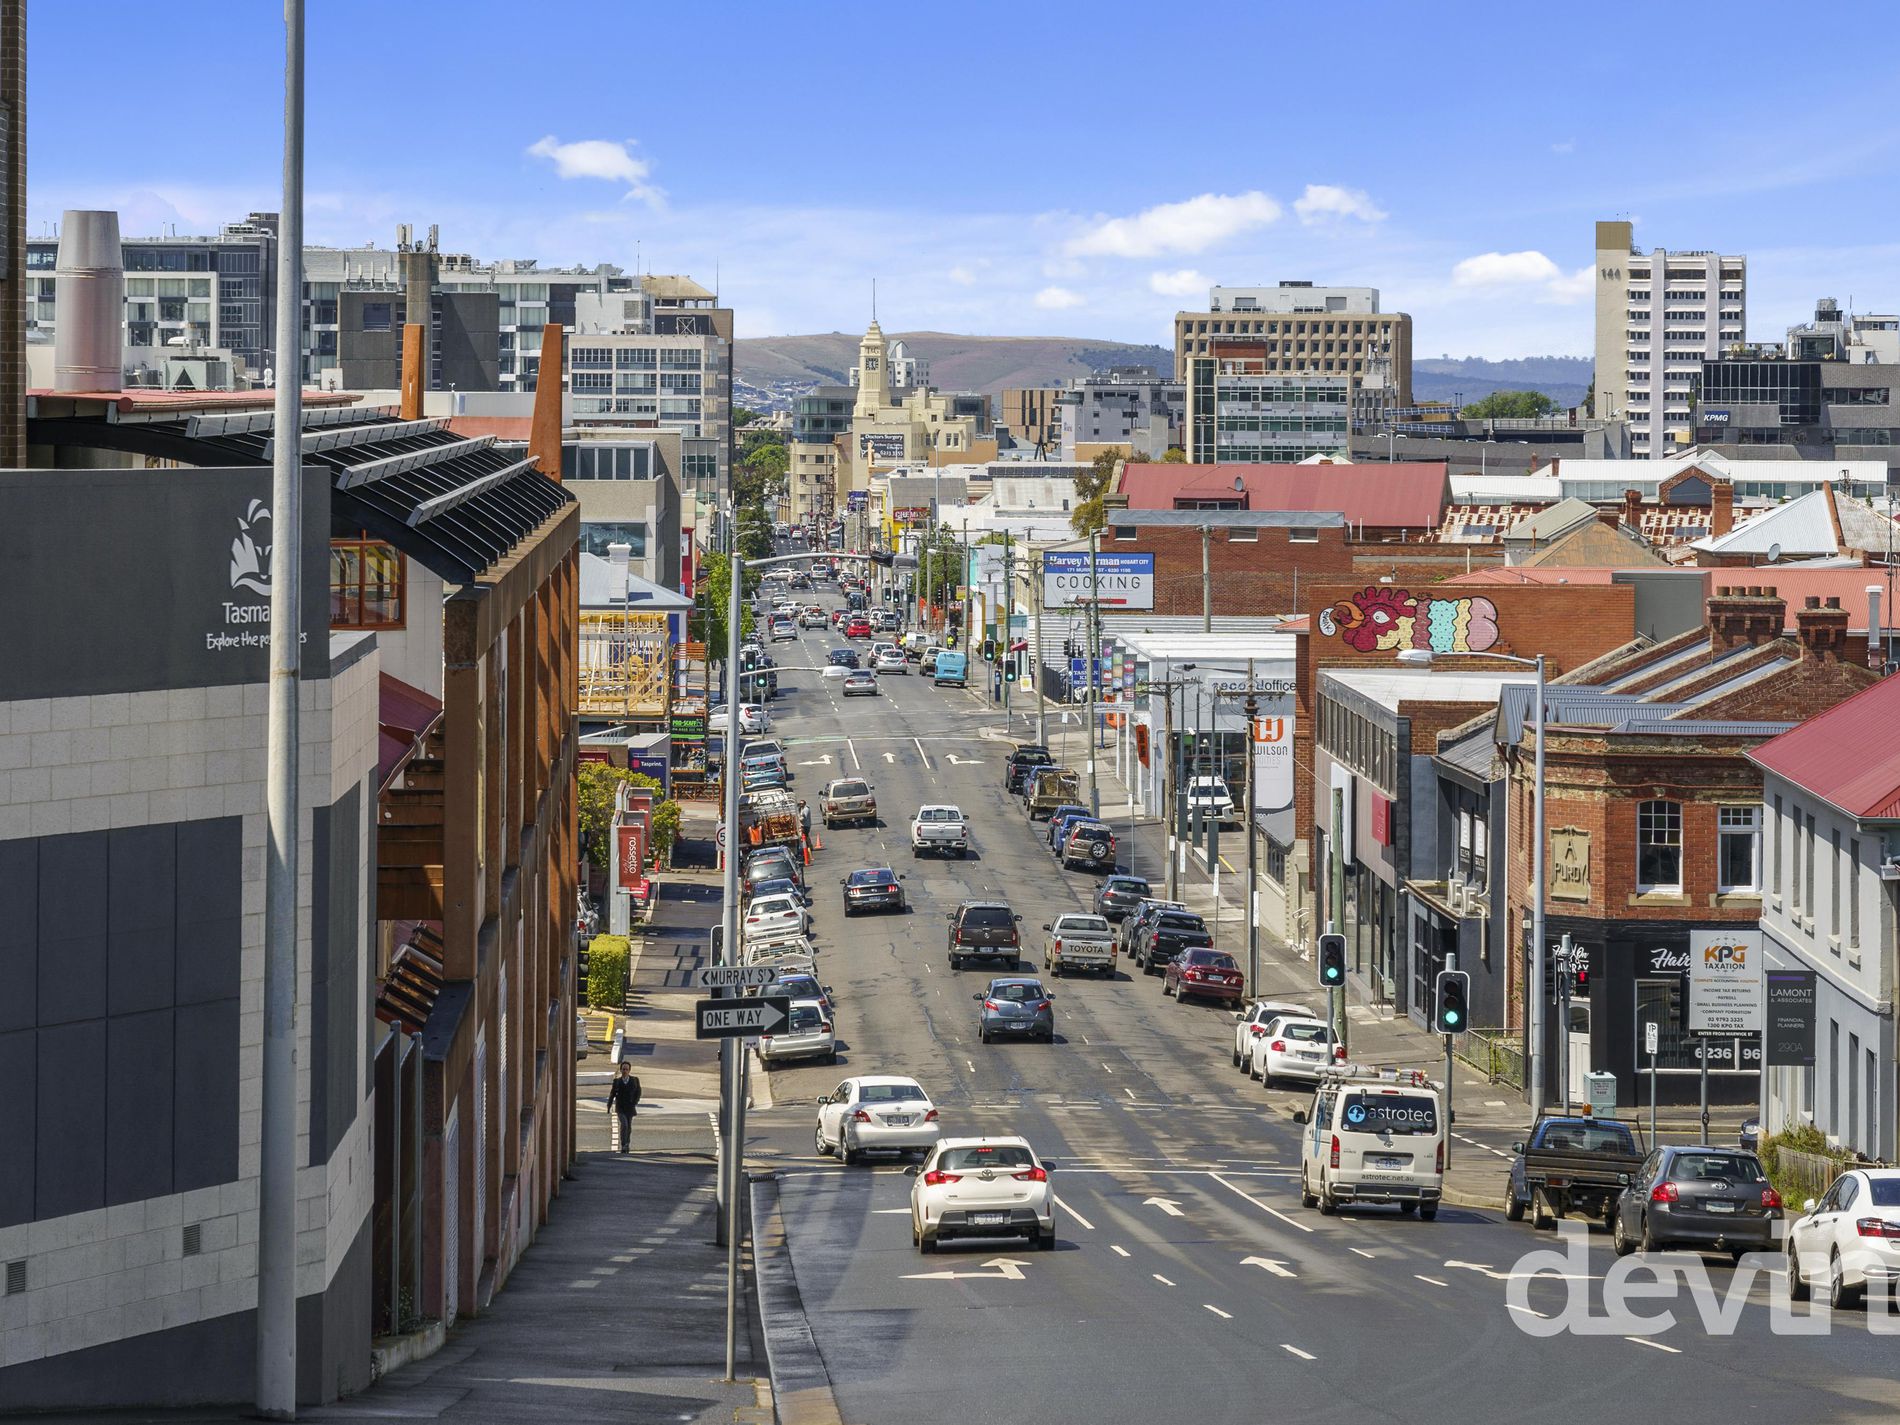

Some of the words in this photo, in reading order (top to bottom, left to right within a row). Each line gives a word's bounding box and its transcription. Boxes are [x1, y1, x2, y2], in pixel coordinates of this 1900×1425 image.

[1703, 414, 1728, 422] KPMG
[1049, 556, 1082, 567] Harvey
[1083, 556, 1120, 566] Nrman
[1056, 576, 1140, 589] COOKING
[222, 602, 271, 624] Tasma
[206, 632, 240, 651] Explore
[241, 631, 259, 647] the
[1254, 745, 1288, 756] WILSON
[628, 836, 637, 874] rossetto
[1565, 839, 1578, 861] A
[1555, 862, 1588, 887] PURDY
[1069, 944, 1104, 954] TOYOTA
[1704, 945, 1748, 963] KPG
[1650, 948, 1691, 969] Hair
[710, 969, 754, 986] MURRAY
[1770, 988, 1813, 997] LAMONT
[706, 1009, 730, 1028] ONE
[736, 1009, 762, 1026] WAY
[1694, 1047, 1733, 1060] 6236
[1742, 1048, 1761, 1060] 96
[1367, 1107, 1433, 1123] astrotec
[1361, 1173, 1415, 1182] astrotec.net.au
